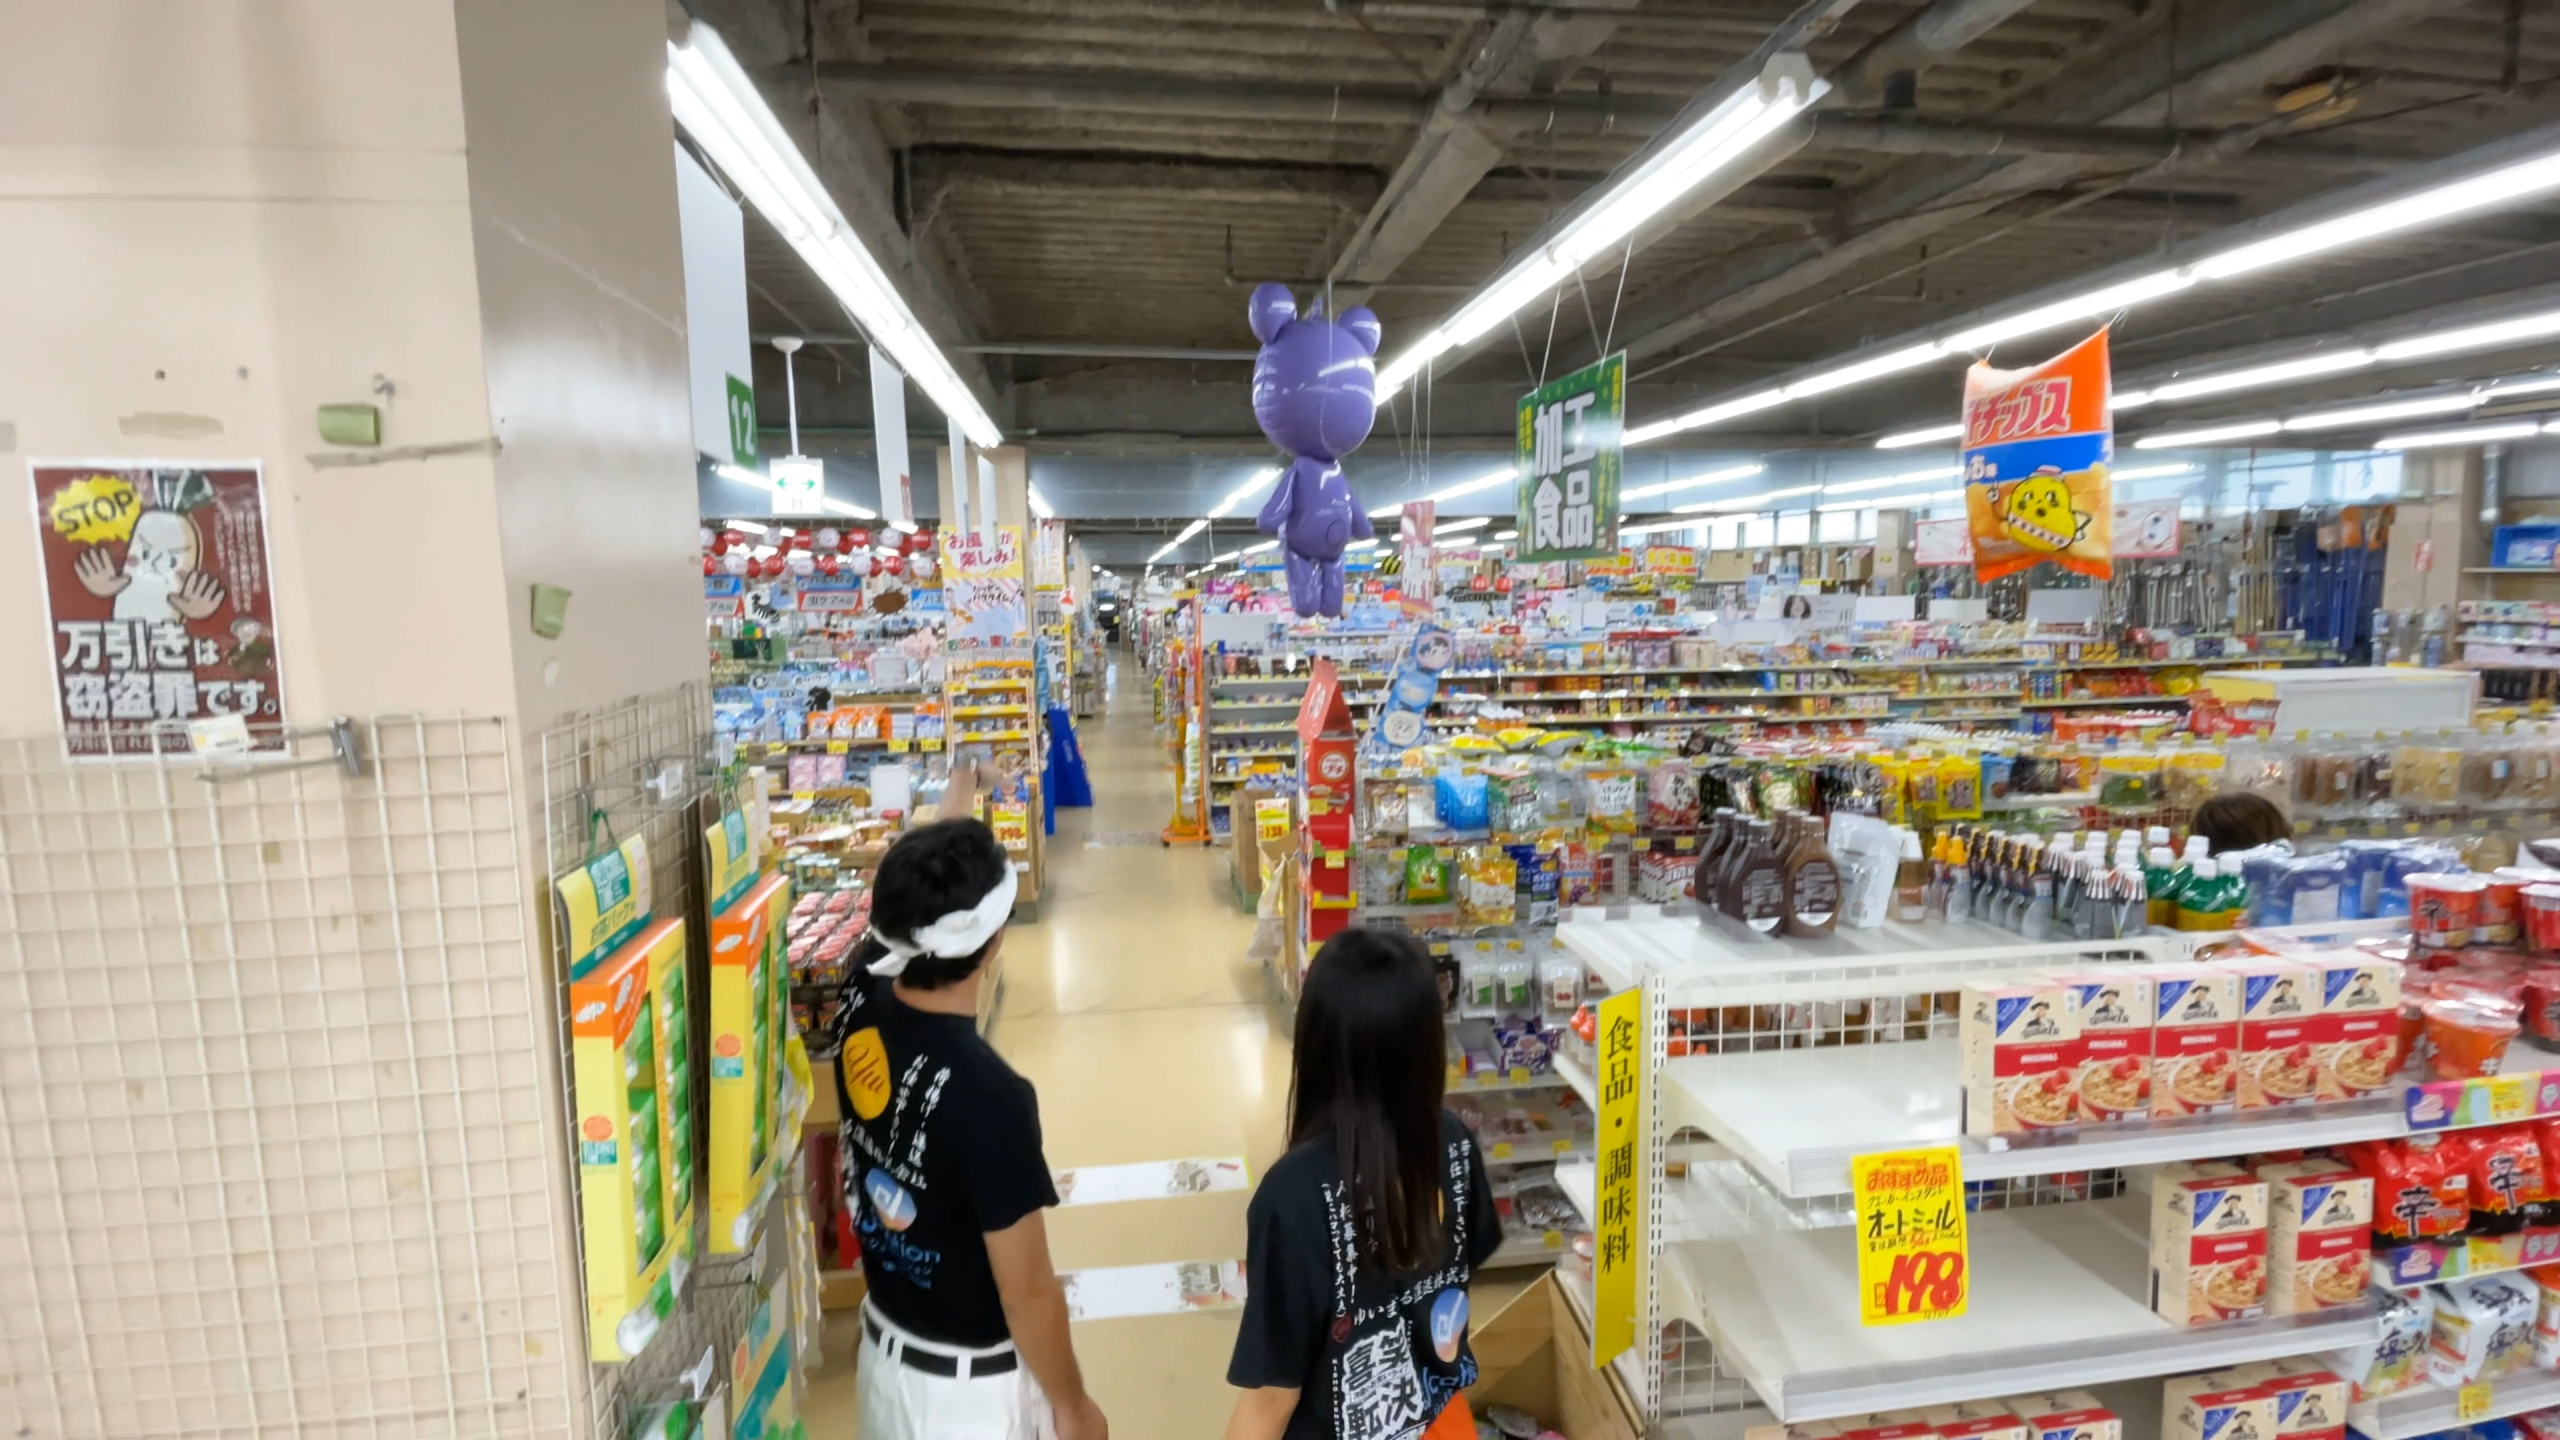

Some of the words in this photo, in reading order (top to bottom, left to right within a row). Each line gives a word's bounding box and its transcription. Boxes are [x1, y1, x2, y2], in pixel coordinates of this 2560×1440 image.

[731, 396, 755, 459] 12
[1534, 391, 1596, 478] 加工
[56, 488, 136, 536] STOP
[1533, 469, 1595, 550] 食品
[57, 618, 221, 671] 万引きは
[1602, 1015, 1634, 1275] 食品・調味料
[1867, 1163, 1950, 1193] おすすめ品
[1867, 1199, 1957, 1239] オートミール
[1886, 1250, 1965, 1317] 198
